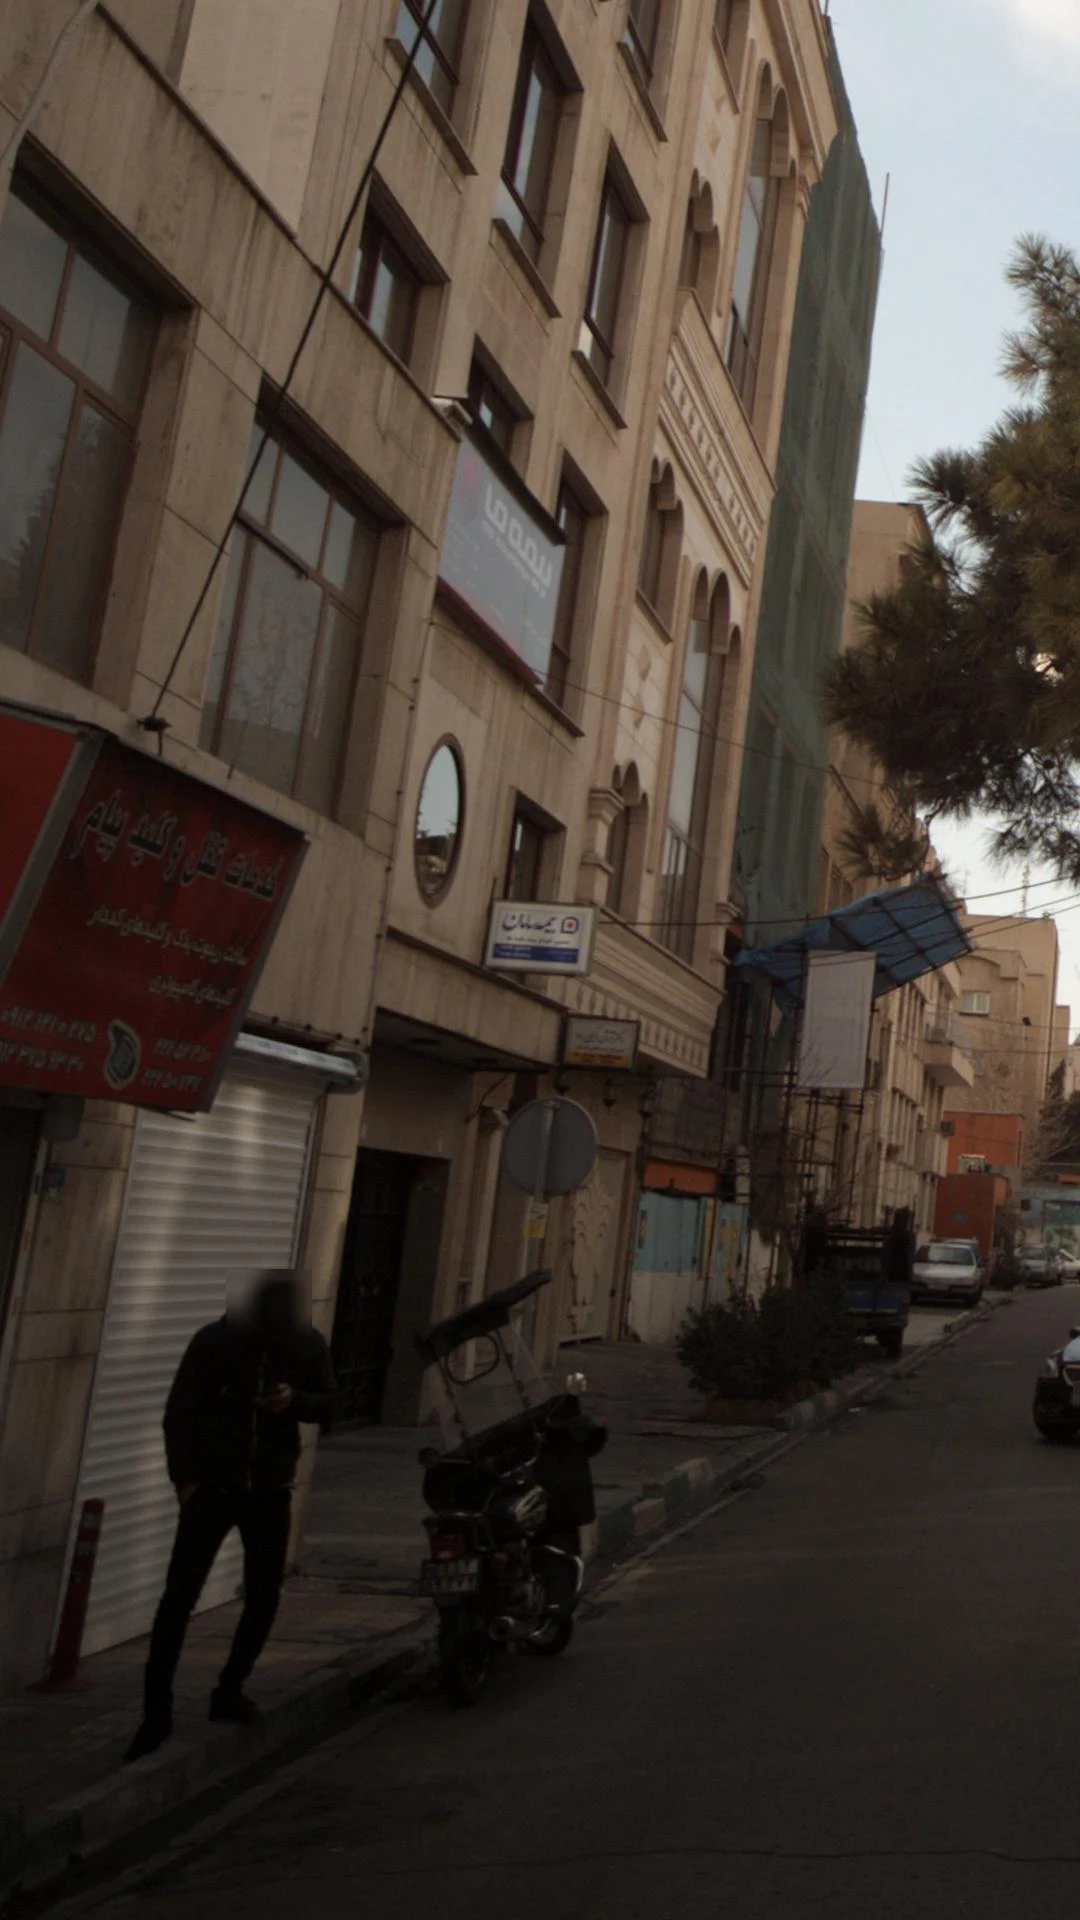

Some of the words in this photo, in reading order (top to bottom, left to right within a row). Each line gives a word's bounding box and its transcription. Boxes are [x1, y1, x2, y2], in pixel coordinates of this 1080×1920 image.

[70, 788, 129, 861] پیام
[127, 808, 177, 867] کلید
[163, 833, 186, 882] و
[180, 832, 229, 886] قفل
[223, 847, 285, 901] خدمات
